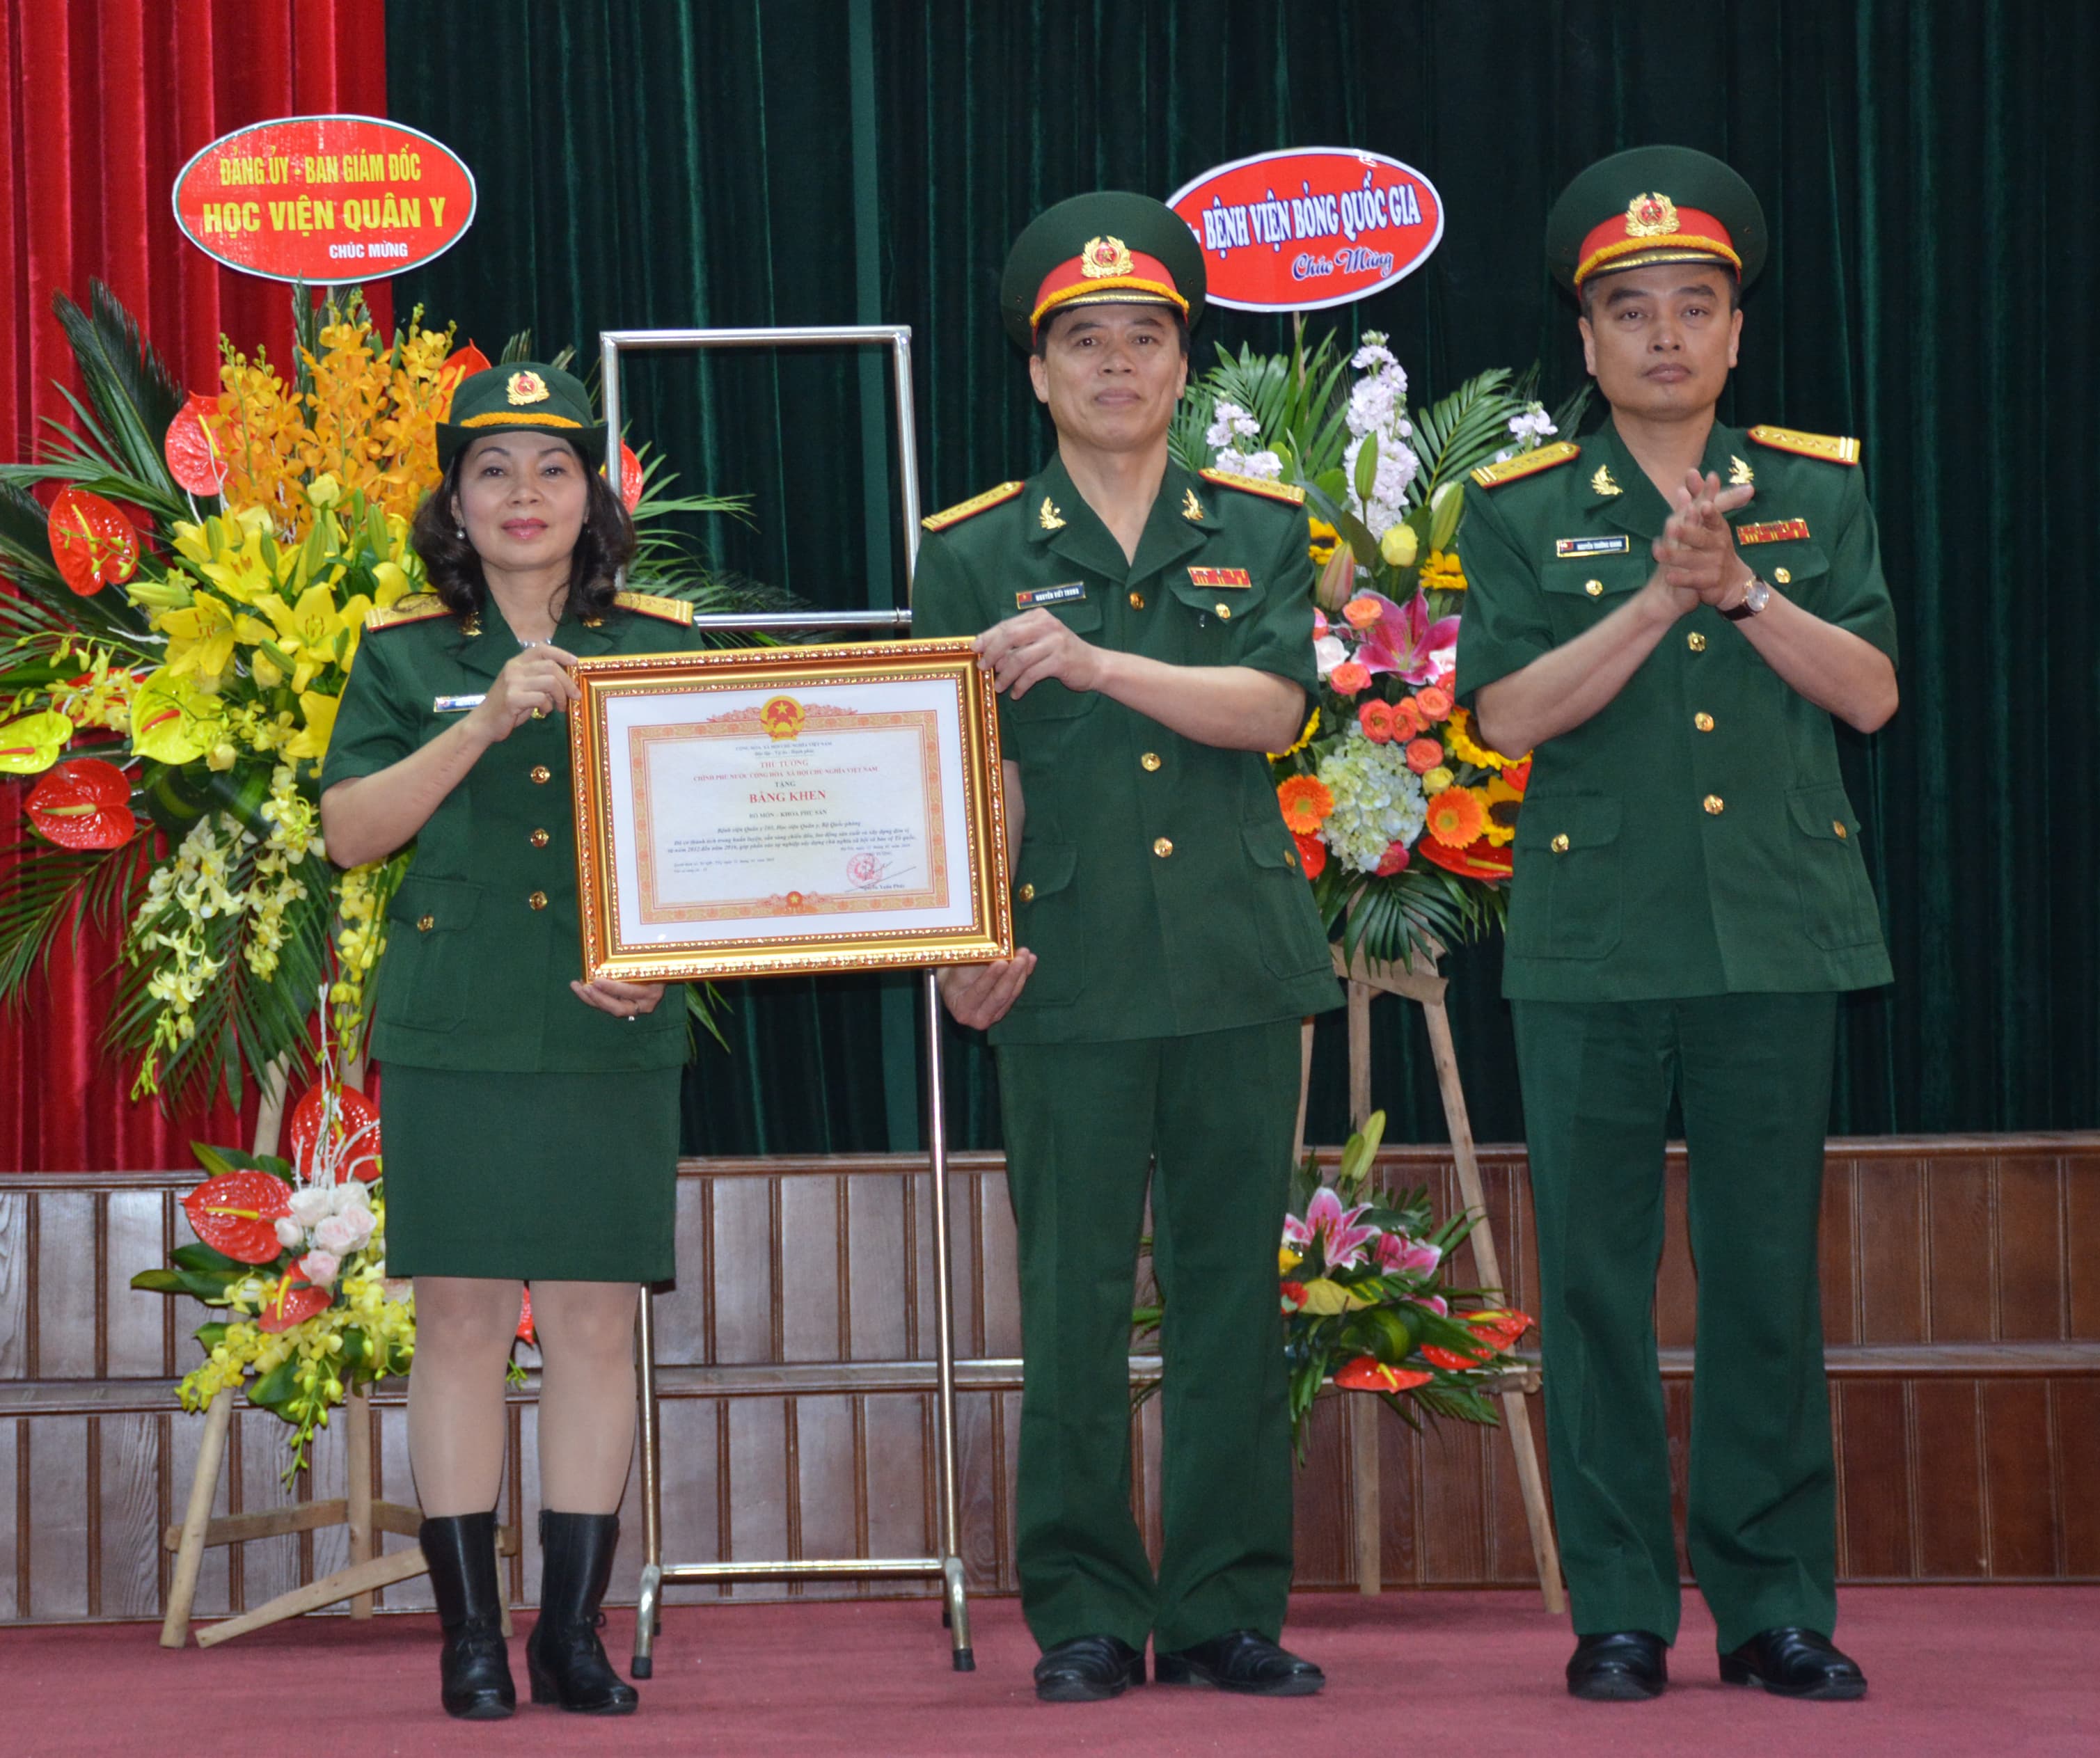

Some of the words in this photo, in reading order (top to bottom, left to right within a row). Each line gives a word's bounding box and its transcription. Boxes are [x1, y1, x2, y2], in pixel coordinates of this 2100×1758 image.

[220, 145, 265, 186] ĐẢNG
[269, 145, 289, 184] ỦY
[305, 155, 339, 184] BAN
[342, 148, 385, 182] GIÁM
[388, 144, 421, 181] ĐỐC
[203, 201, 260, 239] HỌC
[268, 195, 335, 237] VIỆN
[343, 192, 421, 232] QUÂN
[429, 197, 446, 227] Y
[1202, 195, 1251, 259] BỆNH
[1249, 189, 1293, 253] VIỆN
[1341, 169, 1388, 242] QUỐC
[1389, 183, 1422, 227] GIA
[329, 241, 365, 259] CHÚC
[368, 240, 409, 258] MỪNG
[1293, 252, 1334, 280] Chúc
[1334, 246, 1394, 278] Mừng
[789, 790, 827, 802] KHEN
